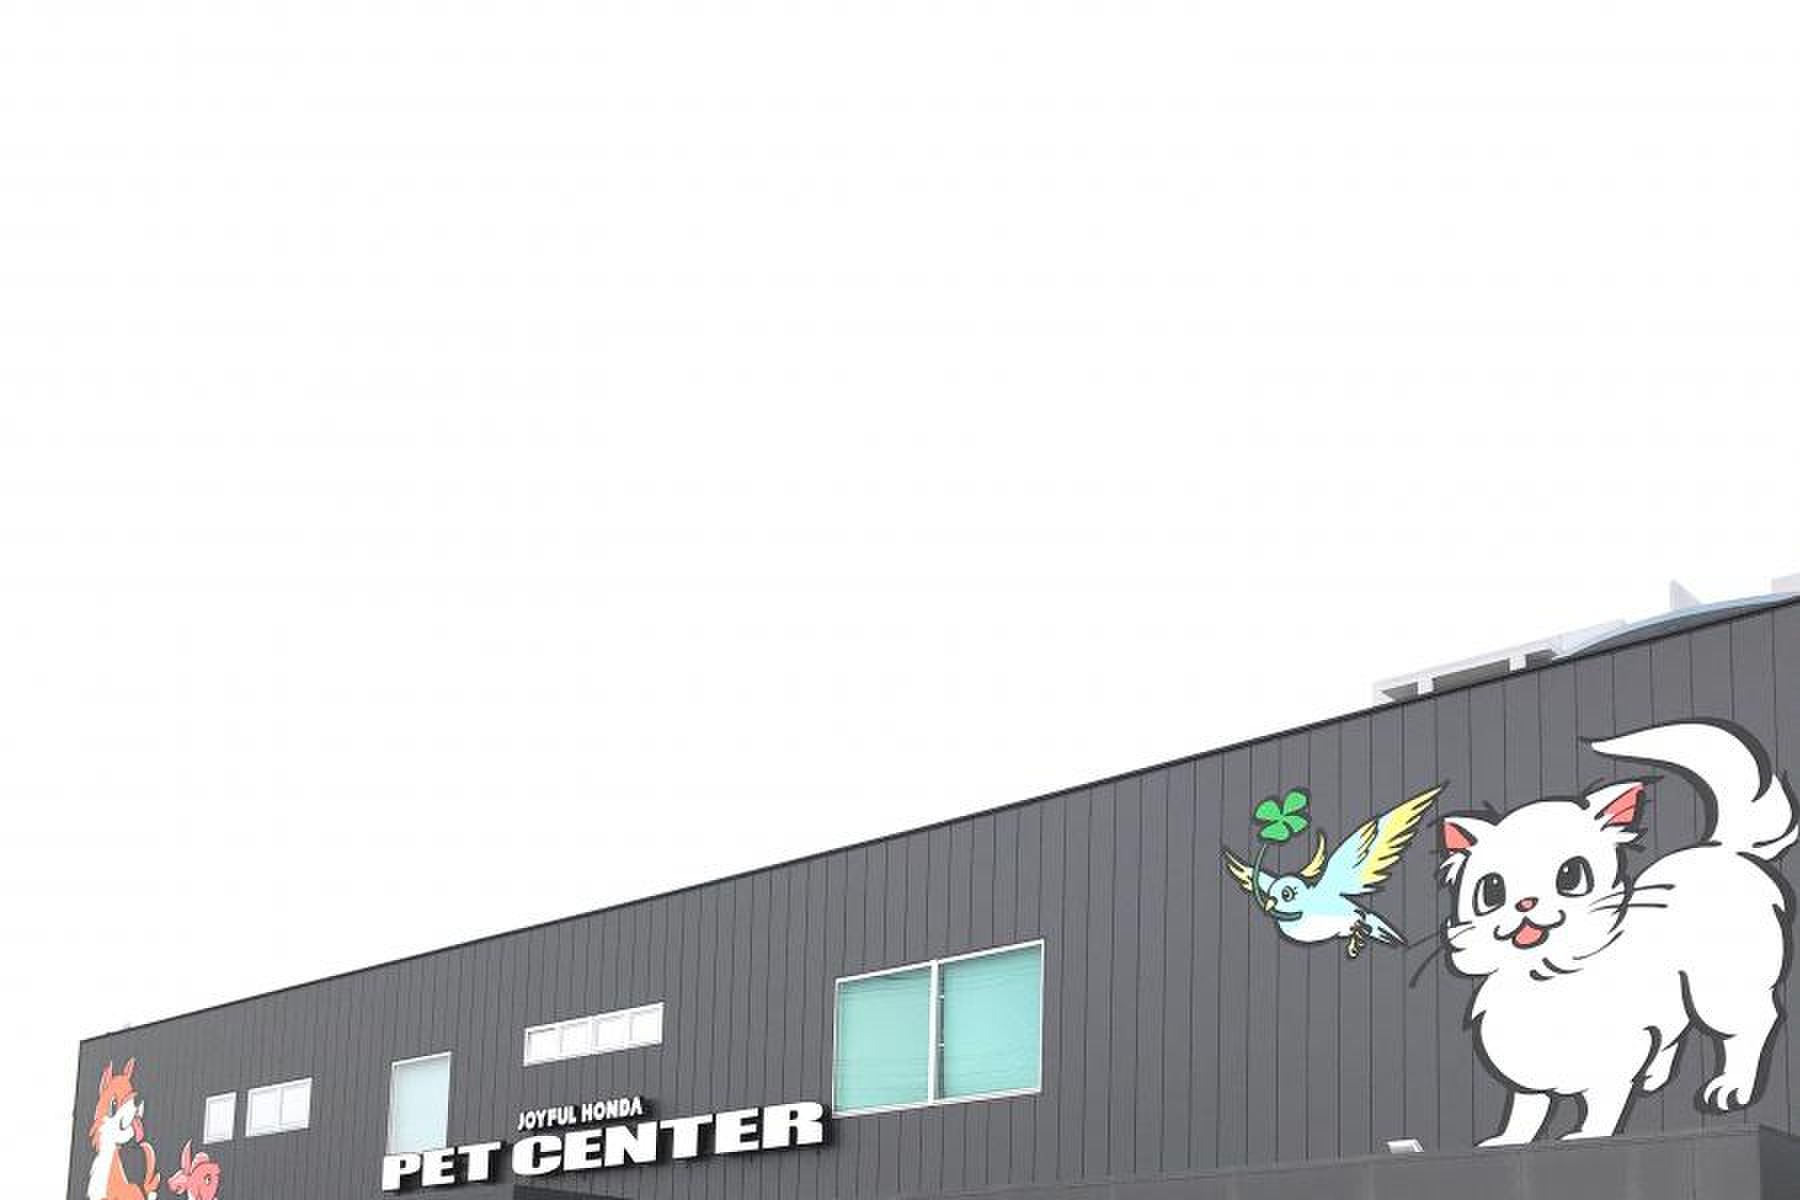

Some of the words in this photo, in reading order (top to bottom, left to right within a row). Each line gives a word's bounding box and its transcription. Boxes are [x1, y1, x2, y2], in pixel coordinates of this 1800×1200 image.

[517, 1106, 577, 1131] JOYFUL
[581, 1096, 644, 1122] HONDA
[382, 1141, 503, 1192] PET
[512, 1101, 825, 1176] CENTER
